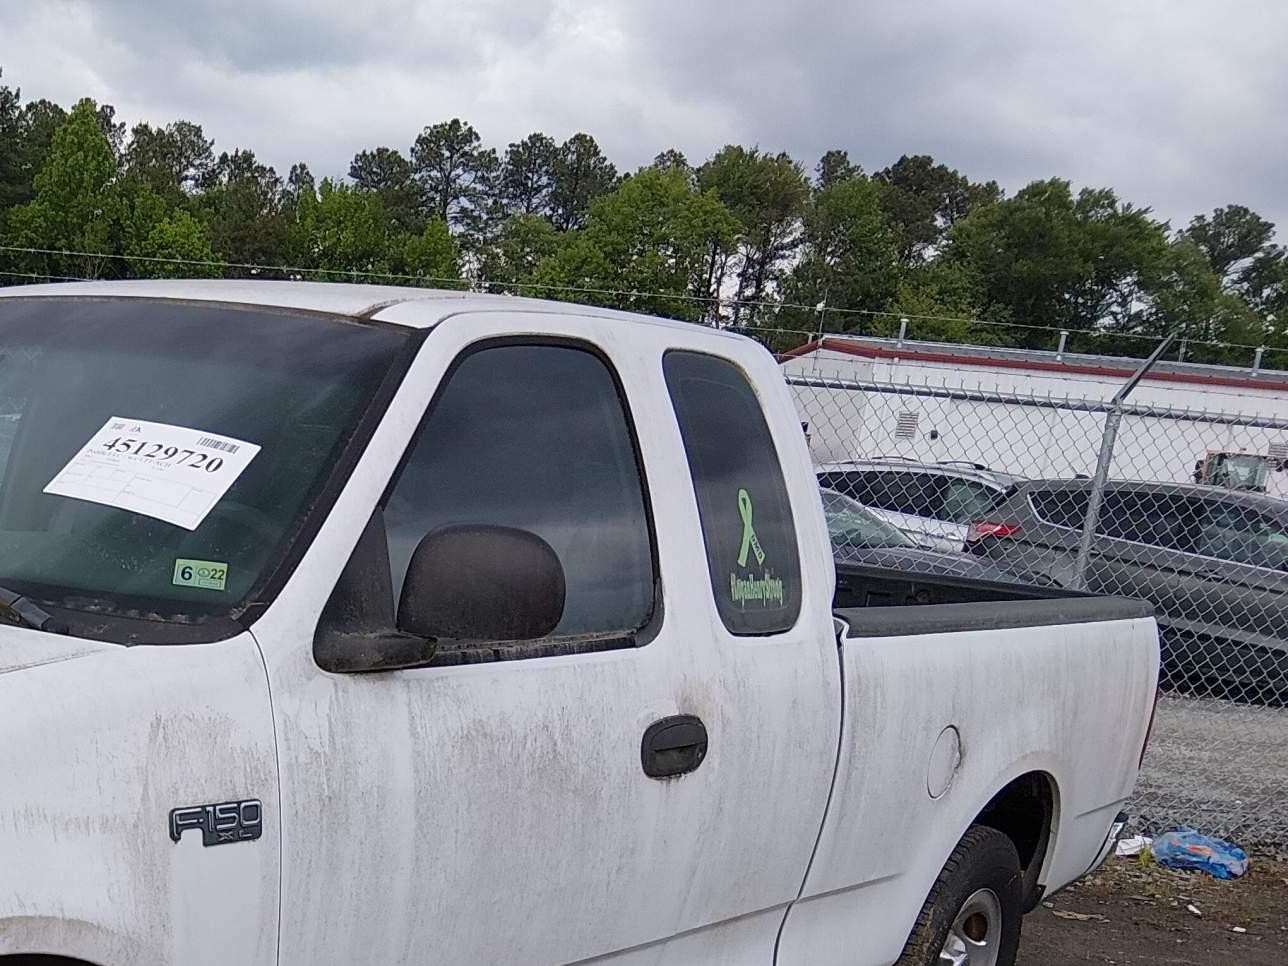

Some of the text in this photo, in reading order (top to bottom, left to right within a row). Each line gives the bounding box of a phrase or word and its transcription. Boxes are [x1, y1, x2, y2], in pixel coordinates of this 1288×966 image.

[103, 436, 224, 473] 45129720
[181, 565, 225, 581] 6 22
[173, 800, 261, 838] F-150
